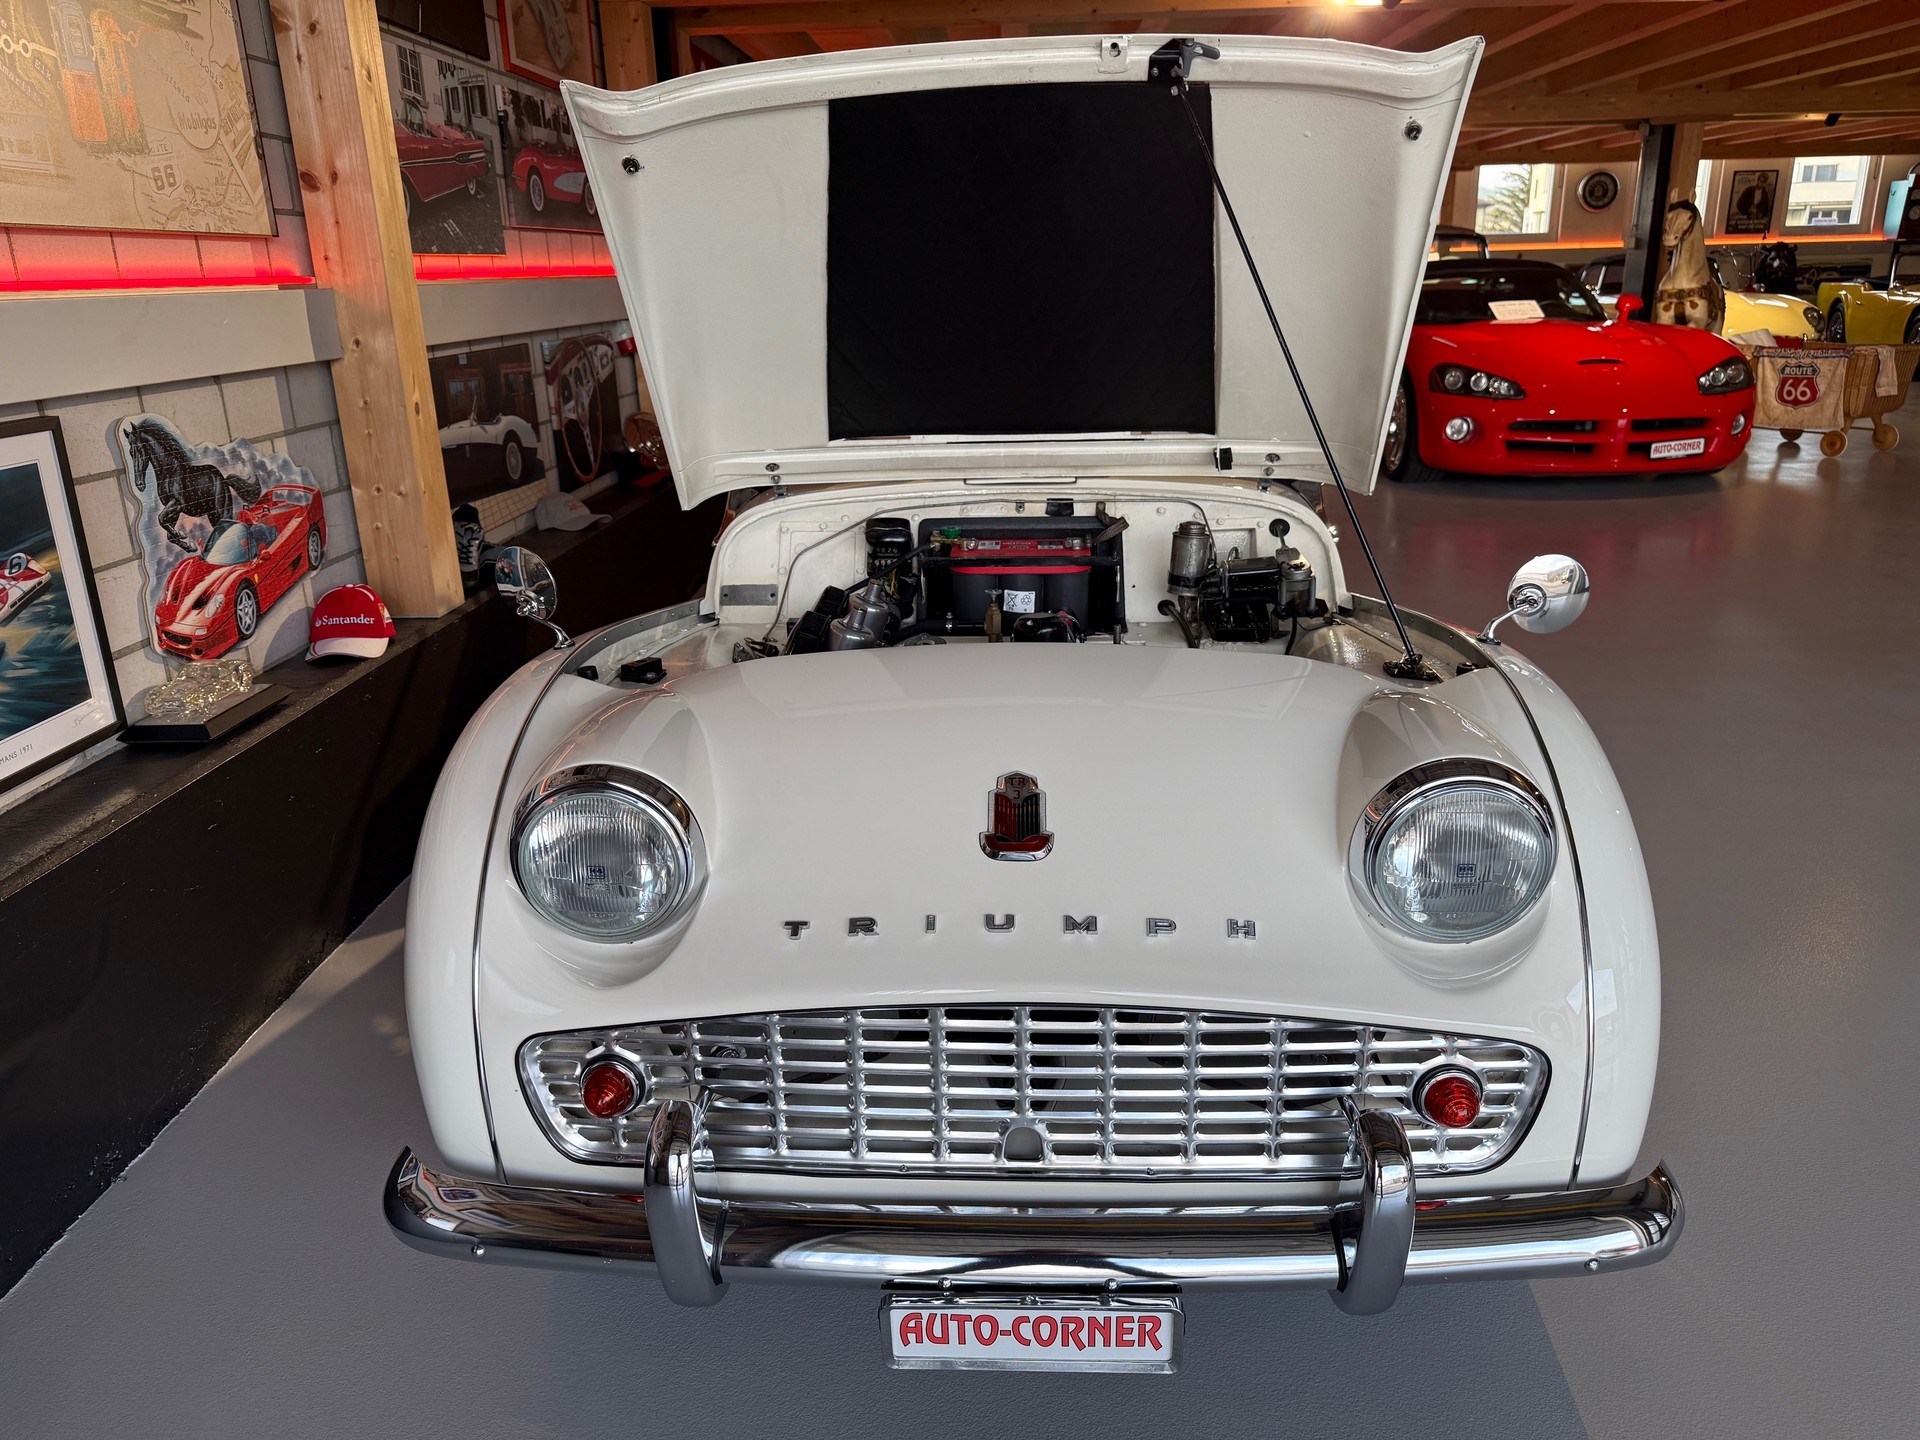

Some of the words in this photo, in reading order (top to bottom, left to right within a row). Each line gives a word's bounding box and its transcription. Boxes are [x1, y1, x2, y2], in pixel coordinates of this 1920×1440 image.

[34, 59, 51, 81] Elk
[184, 40, 195, 56] St
[199, 56, 224, 90] Louis
[178, 112, 217, 135] Mobilgas
[151, 164, 177, 192] 66
[1784, 366, 1813, 375] ROUTE
[1783, 379, 1811, 401] 66
[1652, 441, 1702, 455] AUTO-CORNER
[9, 556, 22, 575] 6
[322, 613, 375, 626] Santander
[19, 743, 33, 755] 1971
[1013, 789, 1021, 799] 3
[782, 913, 1258, 941] TRIUMPH
[899, 1312, 1163, 1351] AUTO-CORNER
